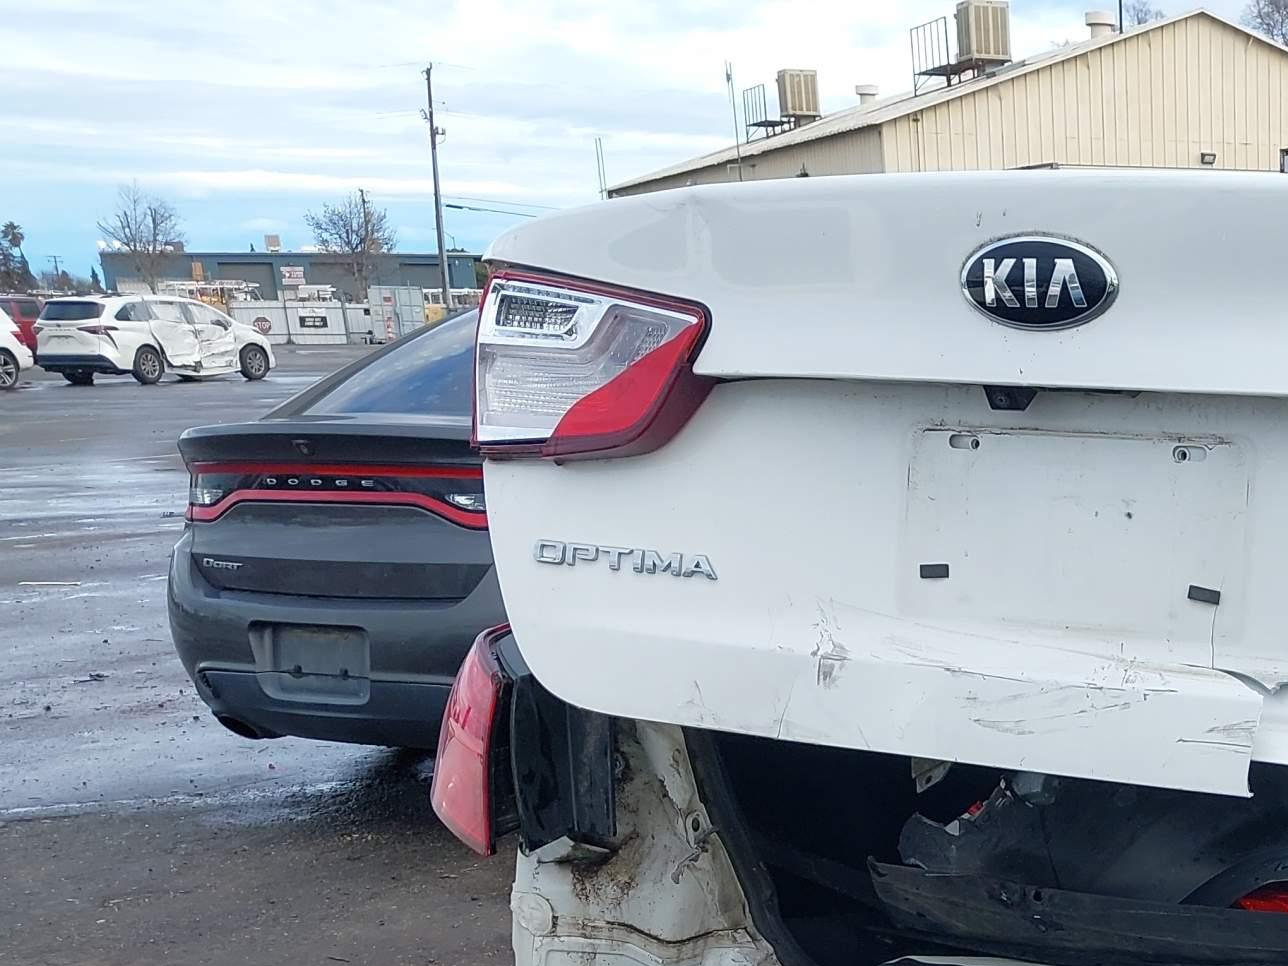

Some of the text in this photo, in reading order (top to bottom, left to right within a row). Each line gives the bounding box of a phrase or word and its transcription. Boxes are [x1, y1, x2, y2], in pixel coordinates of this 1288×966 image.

[983, 257, 1087, 309] KIA
[265, 477, 377, 488] DODGE
[533, 538, 718, 581] OPTIMA
